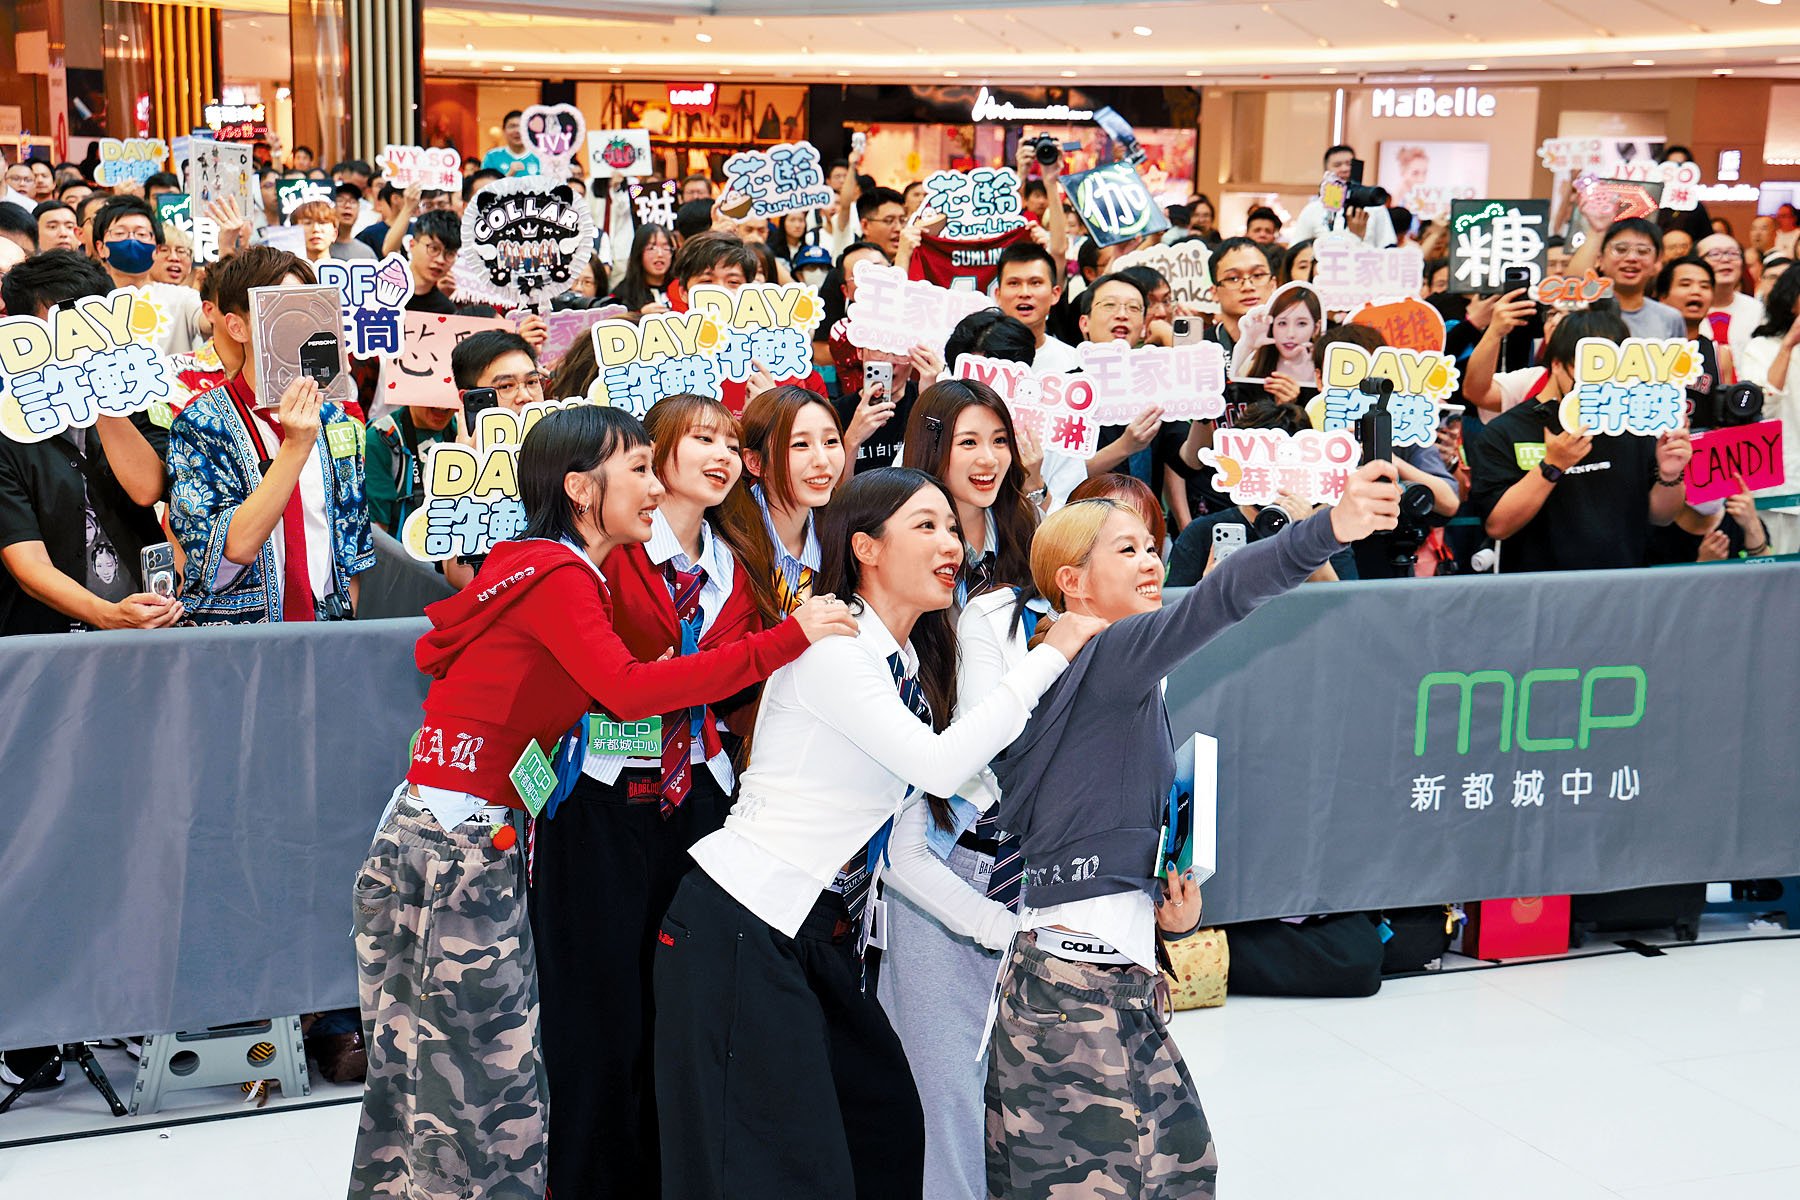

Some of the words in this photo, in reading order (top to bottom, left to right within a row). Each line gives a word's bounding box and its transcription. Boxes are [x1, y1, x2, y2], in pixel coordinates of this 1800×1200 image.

[1372, 87, 1496, 117] MaBelle
[102, 142, 155, 161] DAY
[388, 149, 420, 165] IVY
[430, 152, 456, 168] SO
[536, 131, 573, 152] IVY
[1662, 168, 1694, 184] SO
[473, 198, 580, 242] COLLAR
[634, 190, 677, 230] 琳
[753, 192, 830, 215] SumLing
[1454, 208, 1544, 287] 糖
[1320, 250, 1419, 288] 王家晴
[694, 289, 800, 328] DAY
[0, 294, 132, 375] DAY
[597, 314, 703, 366] DAY
[1085, 346, 1221, 399] 王家晴
[1329, 347, 1440, 394] DAY
[1581, 343, 1682, 382] DAY
[11, 344, 169, 433] 許軼
[961, 361, 1024, 399] IVY
[1043, 375, 1093, 411] SO
[1093, 405, 1155, 420] AND
[1162, 399, 1219, 414] WONG
[1577, 382, 1681, 431] 許軼
[411, 454, 421, 484] SONY
[1222, 436, 1281, 463] IVY
[1300, 436, 1352, 464] SO
[1690, 433, 1780, 488] CANDY
[431, 449, 520, 497] DA
[1239, 467, 1349, 499] 蘇雅琳
[477, 567, 535, 602] COLLAR
[593, 737, 658, 752] 新都城中心
[516, 765, 543, 810] 新都城中心
[670, 769, 686, 790] DAY
[1410, 765, 1640, 811] 新都城中心
